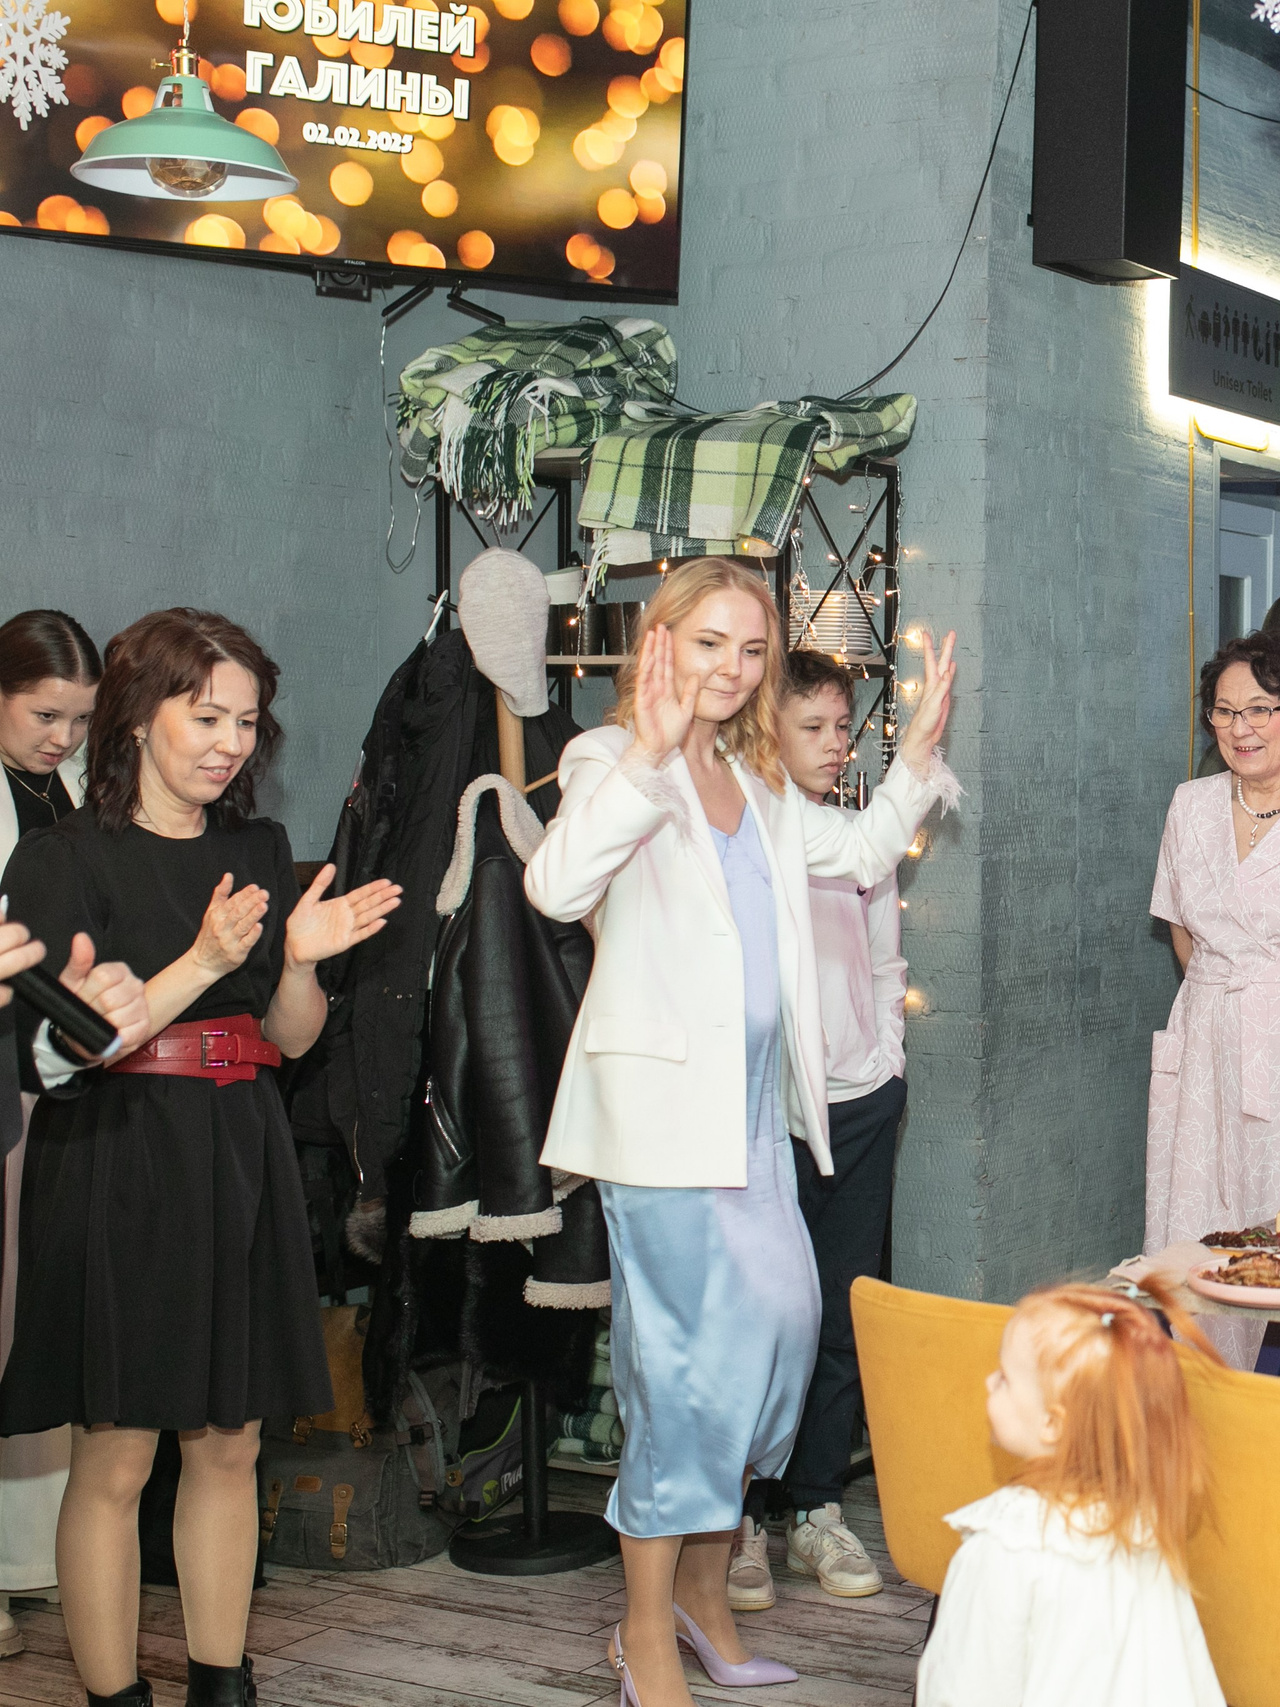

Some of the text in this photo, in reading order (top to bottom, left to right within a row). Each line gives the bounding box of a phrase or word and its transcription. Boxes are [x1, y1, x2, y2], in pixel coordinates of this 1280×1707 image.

[243, 0, 476, 57] ЮБИЛЕЙ
[246, 50, 470, 120] ГАЛИНЫ
[302, 122, 414, 154] 02.02.2025
[1213, 369, 1273, 403] Unisex Toilet
